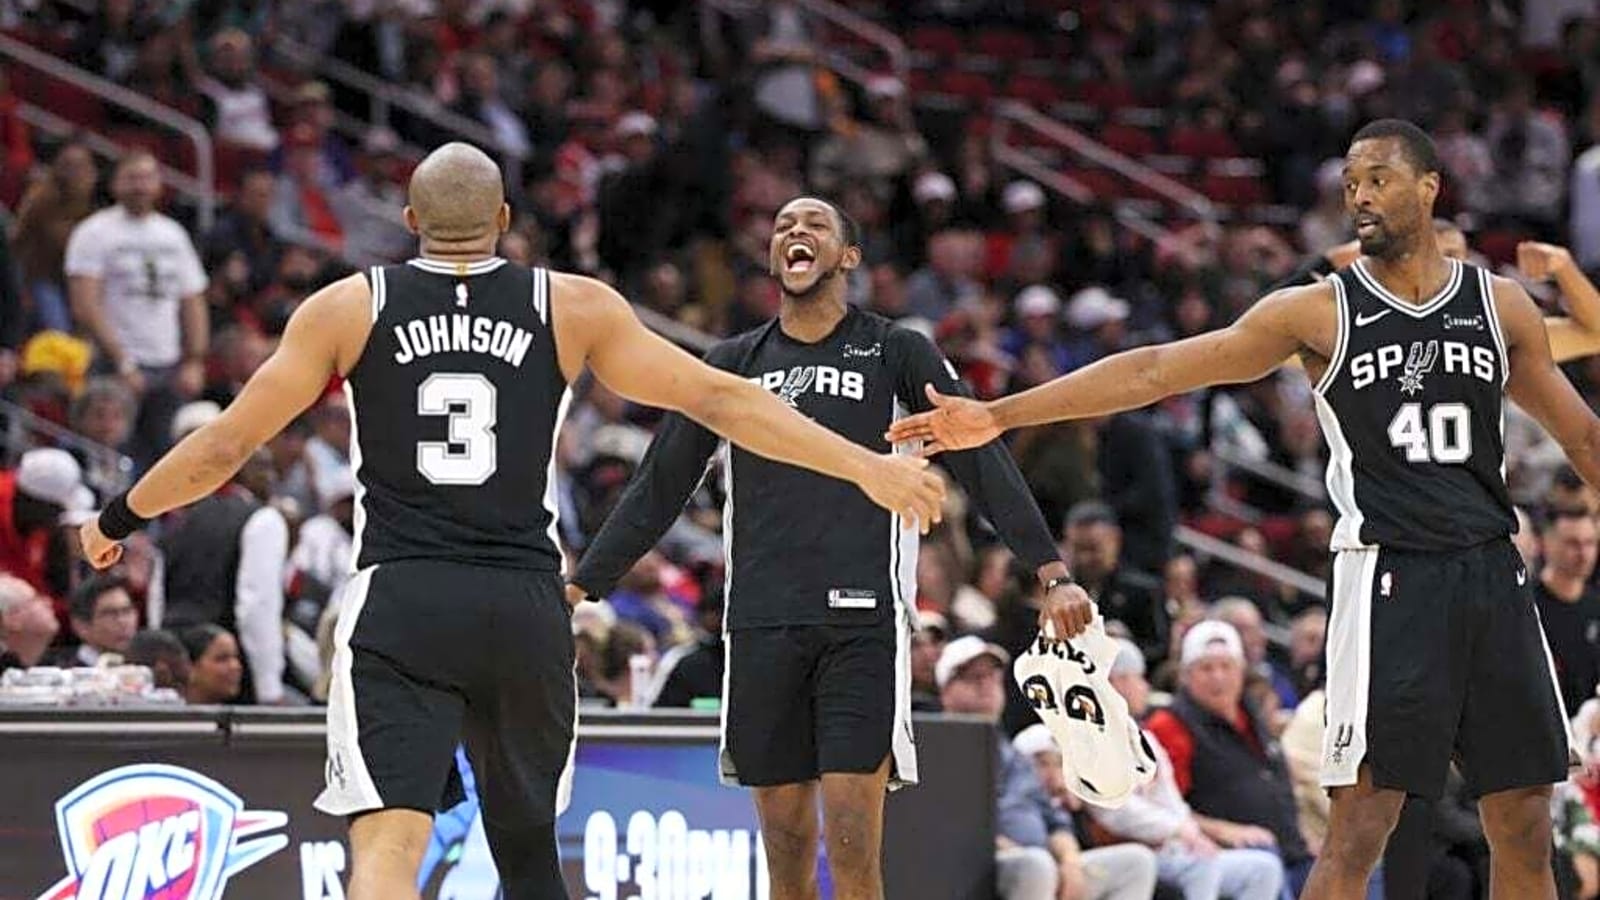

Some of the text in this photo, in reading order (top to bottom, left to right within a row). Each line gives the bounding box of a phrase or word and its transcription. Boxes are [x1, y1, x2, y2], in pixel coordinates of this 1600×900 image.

[394, 313, 534, 367] JOHNSON
[1350, 340, 1495, 396] SPURS
[745, 365, 864, 408] PURS
[416, 372, 498, 486] 3
[1387, 402, 1473, 464] 40
